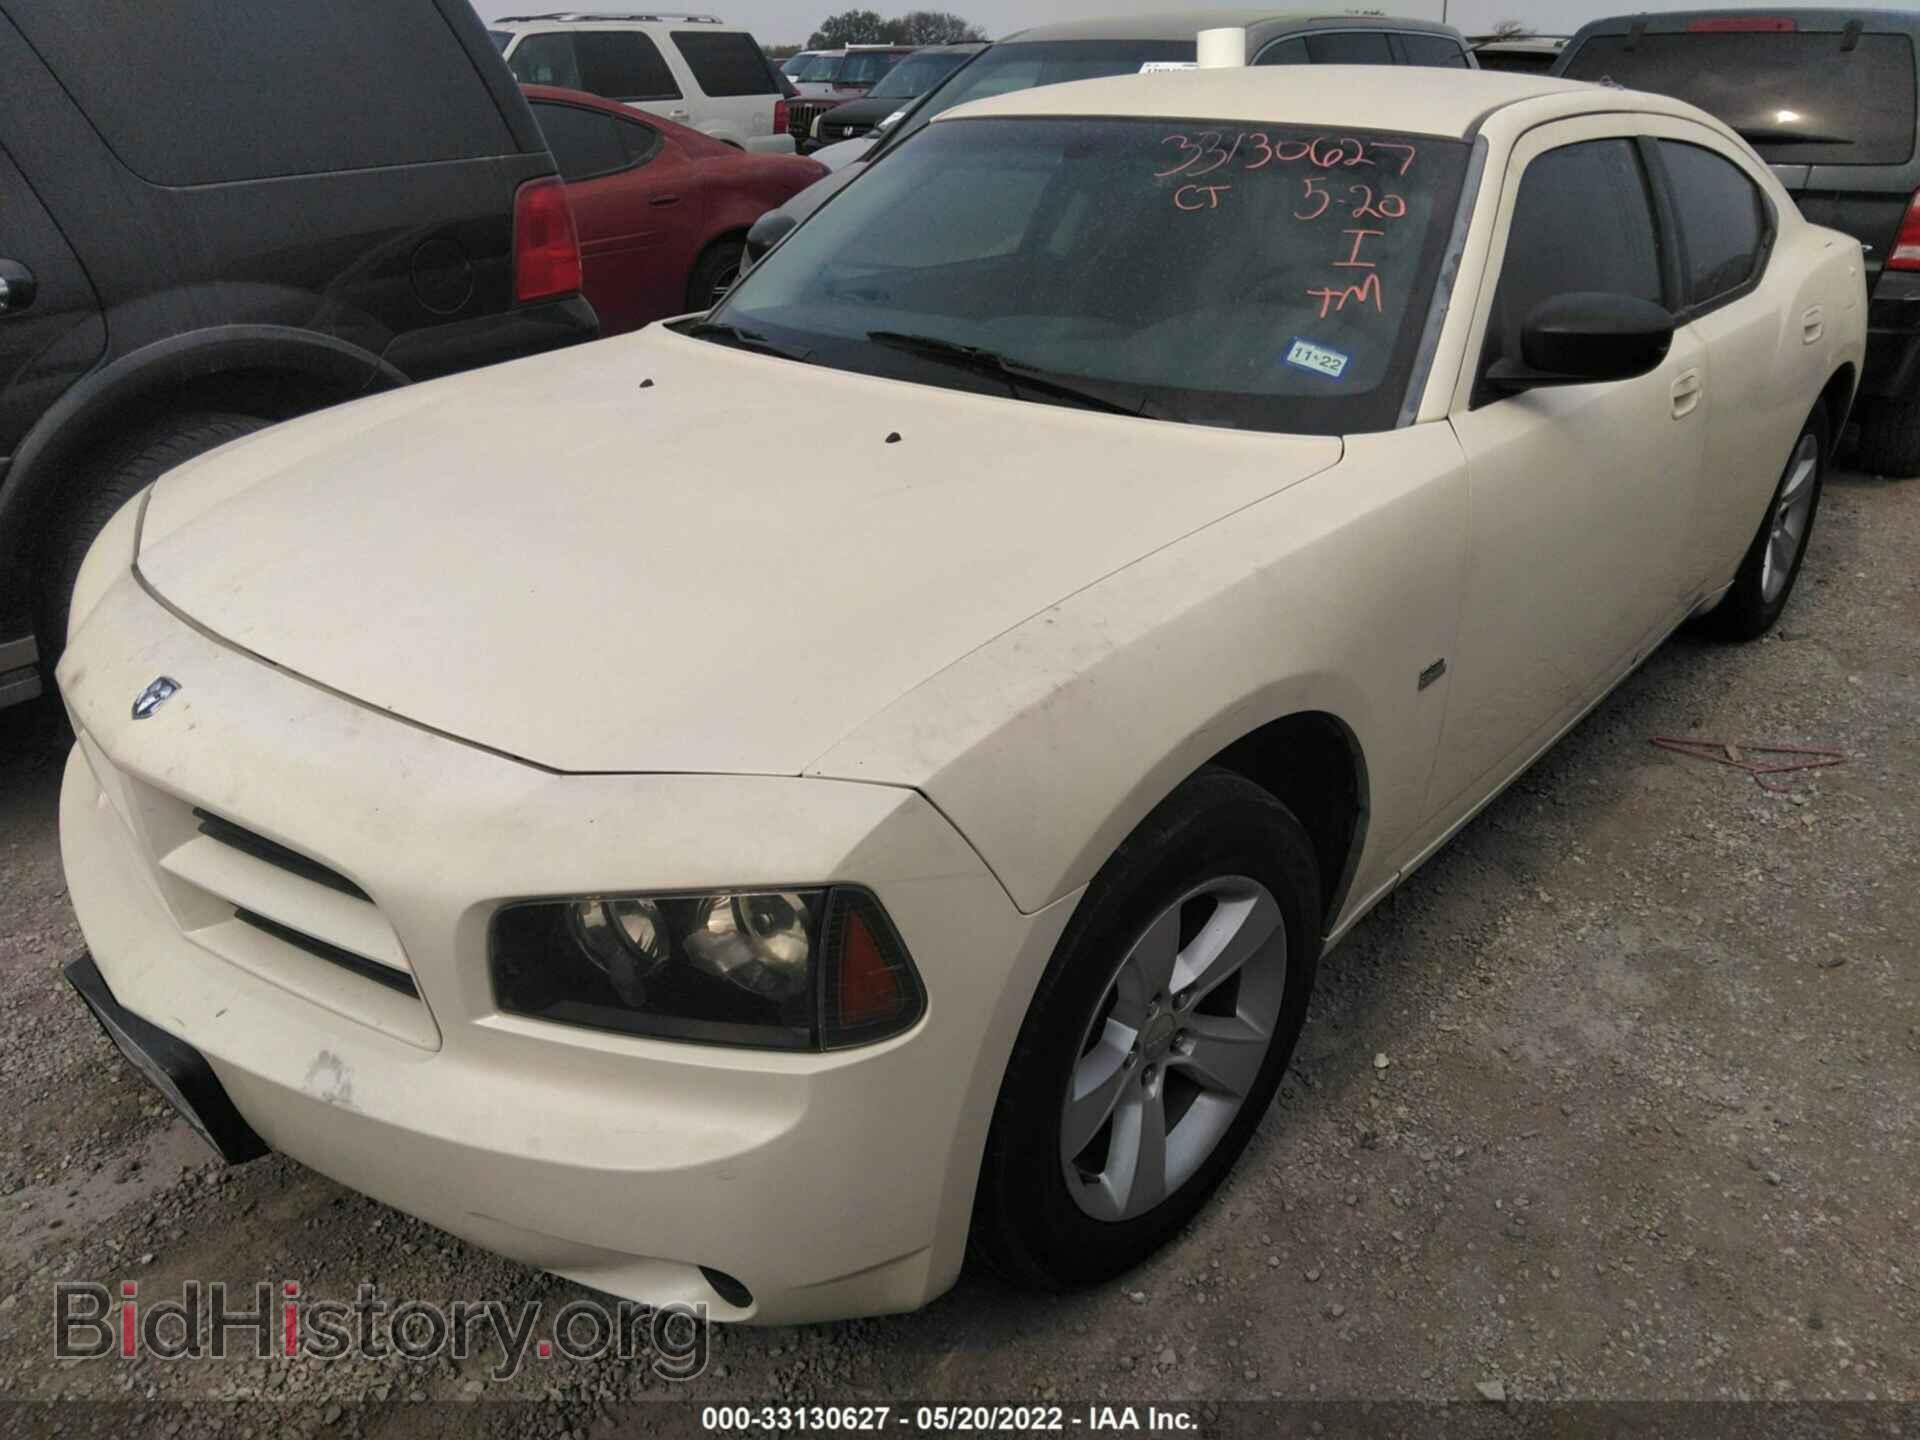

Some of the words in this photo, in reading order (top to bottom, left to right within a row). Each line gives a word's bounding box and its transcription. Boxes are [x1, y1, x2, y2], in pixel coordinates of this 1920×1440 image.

[1154, 132, 1415, 176] 33130627
[1174, 184, 1232, 210] CT
[1294, 176, 1406, 220] 5-20
[1307, 273, 1382, 319] TM
